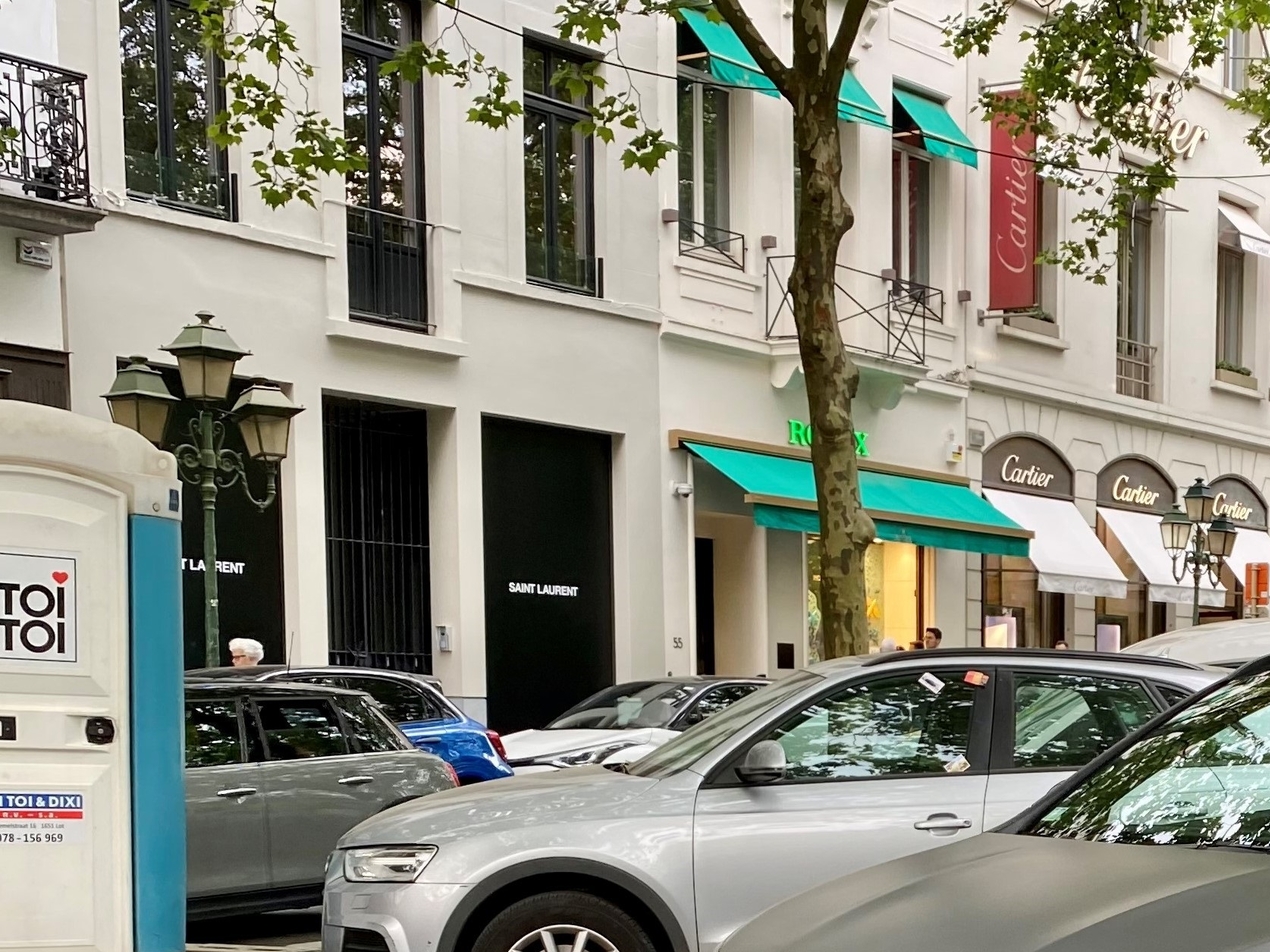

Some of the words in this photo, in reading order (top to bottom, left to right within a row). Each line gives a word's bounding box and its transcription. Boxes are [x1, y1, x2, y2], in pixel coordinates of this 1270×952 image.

[996, 135, 1030, 274] Cartier
[1001, 454, 1054, 488] Cartier
[1112, 474, 1160, 506] Cartier
[1212, 492, 1253, 521] Cartier
[189, 558, 246, 575] LARENT
[508, 581, 536, 594] SAINT
[537, 583, 578, 597] LAURENT
[0, 618, 65, 654] TOI
[673, 637, 683, 649] 55
[6, 795, 33, 807] TOI
[36, 796, 46, 807] &
[48, 796, 80, 807] DIXI
[23, 833, 42, 843] 156
[44, 833, 63, 843] 969
